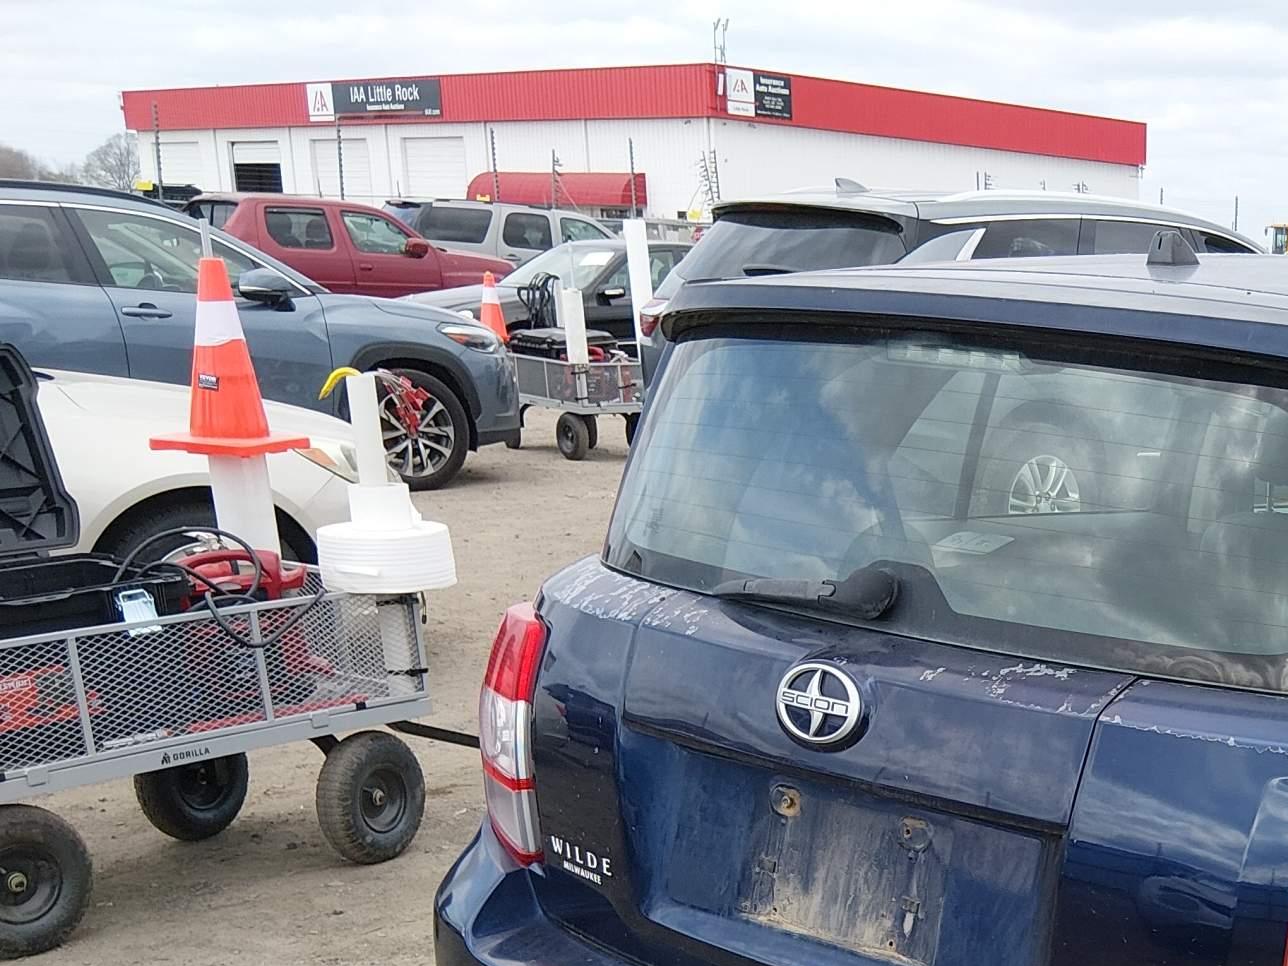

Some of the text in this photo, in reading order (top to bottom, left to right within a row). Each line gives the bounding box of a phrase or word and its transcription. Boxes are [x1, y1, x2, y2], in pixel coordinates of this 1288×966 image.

[350, 83, 420, 103] IAA Little Rock
[172, 747, 211, 761] GORILLA
[550, 834, 613, 877] WILDE
[562, 859, 603, 886] MILWAUKEE
